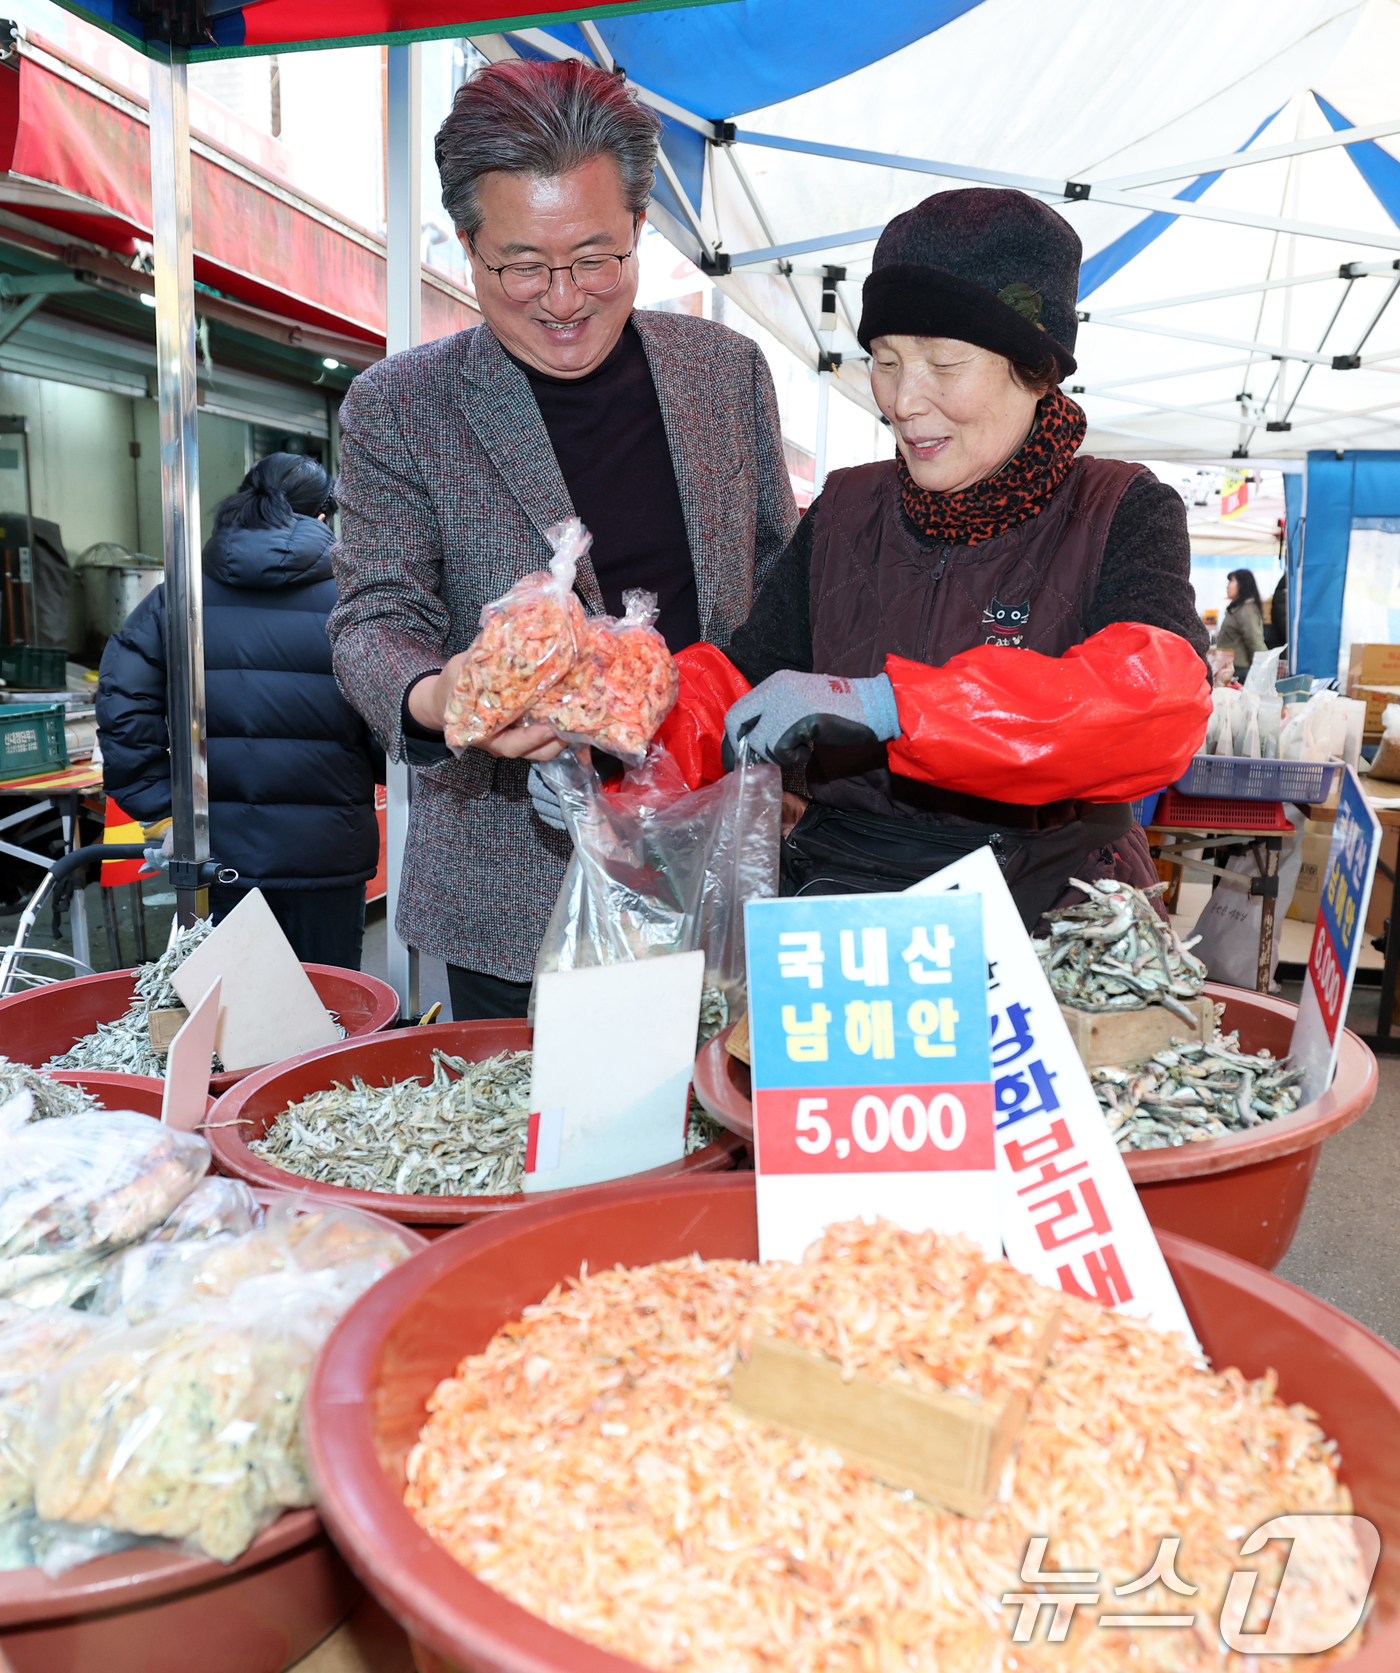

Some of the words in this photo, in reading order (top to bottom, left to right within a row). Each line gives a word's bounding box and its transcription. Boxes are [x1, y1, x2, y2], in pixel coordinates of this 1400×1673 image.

[1328, 855, 1355, 949] 남해안
[777, 924, 955, 989] 국내산
[1314, 927, 1340, 1016] 6,000
[781, 997, 960, 1062] 남해안
[795, 1092, 967, 1159] 5,000
